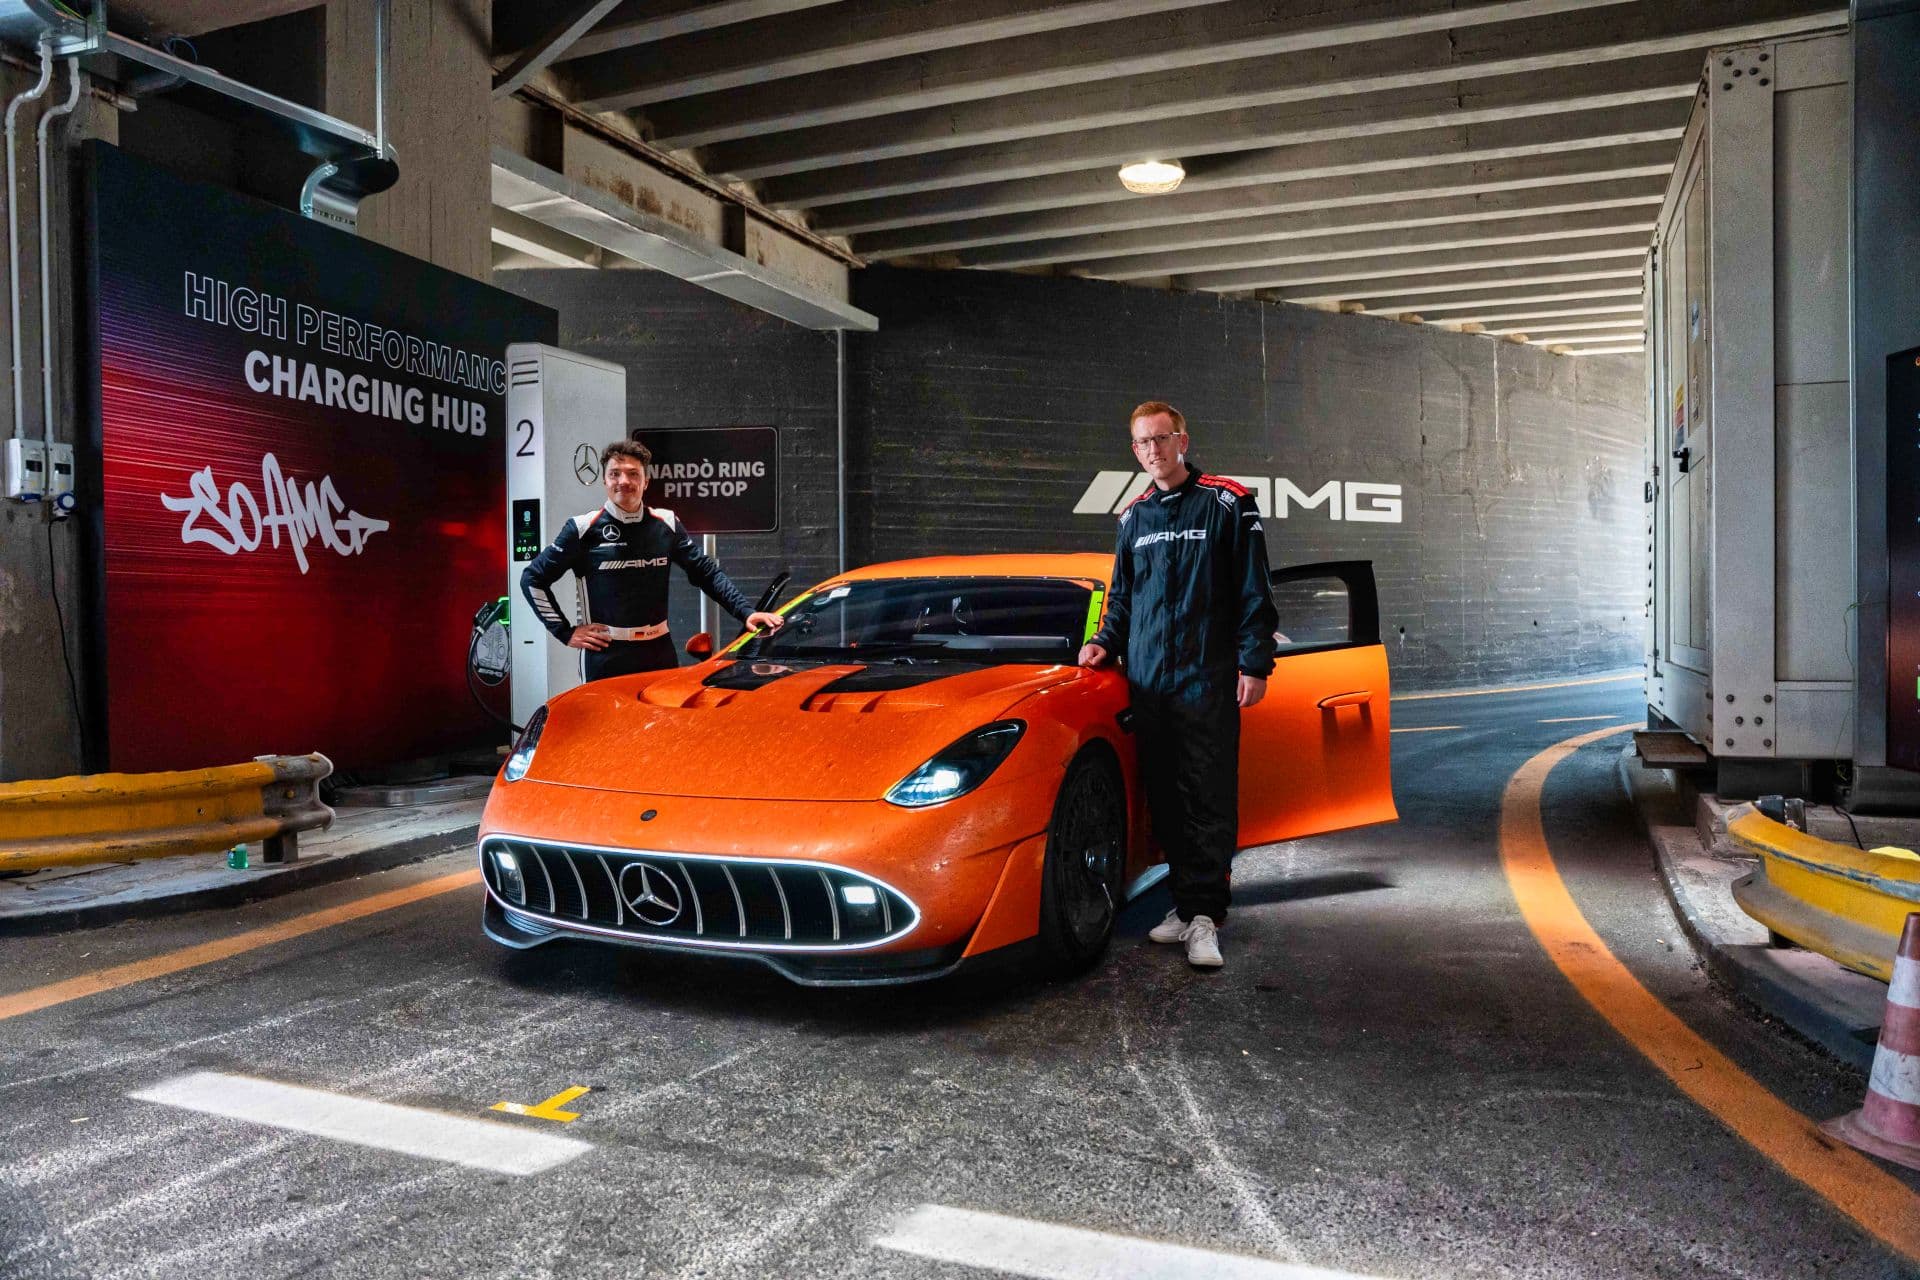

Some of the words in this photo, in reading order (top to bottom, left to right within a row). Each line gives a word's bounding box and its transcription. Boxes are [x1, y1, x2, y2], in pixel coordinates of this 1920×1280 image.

[185, 271, 287, 340] HIGH
[296, 304, 506, 395] PERFORMANC
[244, 350, 424, 424] CHARGING
[432, 392, 487, 437] HUB
[516, 419, 535, 457] 2
[646, 458, 714, 479] NARDÒ
[718, 461, 766, 478] RING
[664, 482, 694, 498] PIT
[697, 481, 748, 498] STOP
[1154, 529, 1207, 544] AMG
[624, 556, 668, 568] AMG
